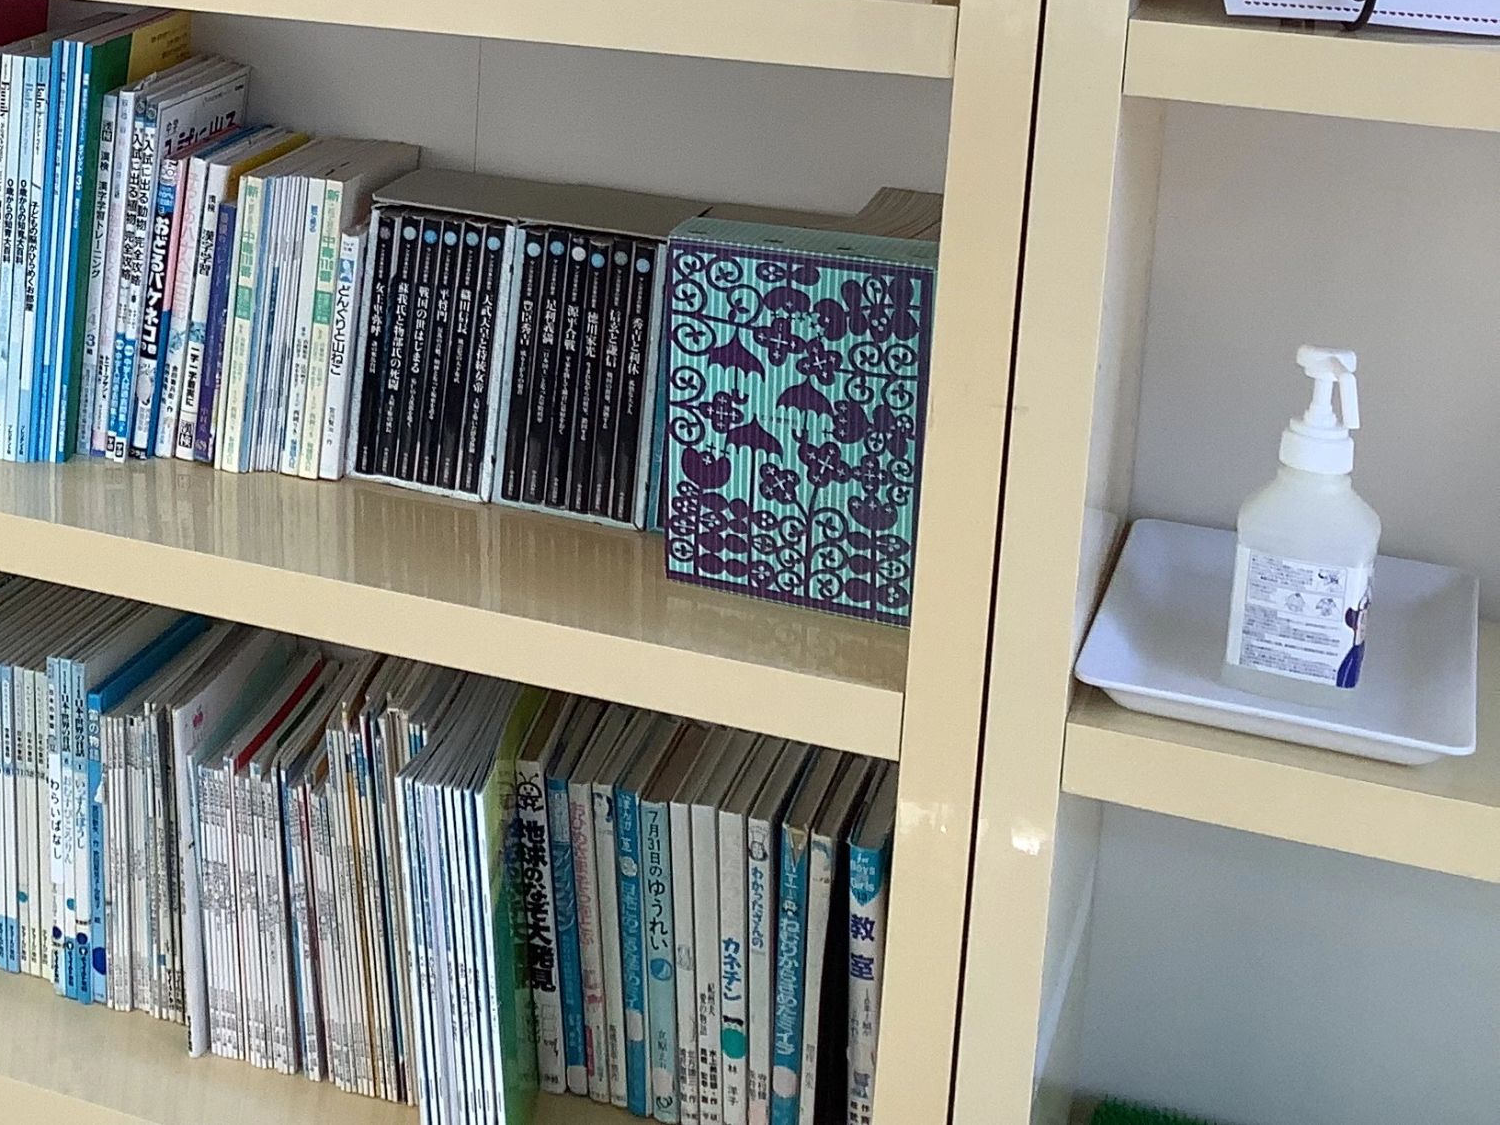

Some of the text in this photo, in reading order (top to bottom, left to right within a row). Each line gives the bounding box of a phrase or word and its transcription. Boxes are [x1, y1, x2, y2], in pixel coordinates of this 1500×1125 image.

[124, 133, 144, 225] 入試に出る植物
[135, 137, 154, 230] 入試に出る動物
[2, 178, 14, 264] 0歳からの知育大百科
[15, 179, 27, 265] 0歳からの知育大百科
[328, 284, 350, 377] どんぐりと山ねこ
[370, 282, 387, 337] 女王卑弥呼
[411, 286, 430, 373] 戦国の世はじまる
[436, 288, 449, 323] 平将門
[457, 289, 472, 335] 織田信長
[520, 300, 534, 346] 豊臣秀吉
[585, 312, 599, 358] 徳川家光
[605, 309, 621, 368] 信玄と謙信
[627, 318, 644, 375] 秀吉と利休
[50, 780, 63, 860] わらいばなし
[74, 779, 86, 850] いっすんぼうし
[514, 819, 557, 992] 地球のなぞ大発見
[647, 811, 669, 950] 7月31日のゆうれい
[751, 866, 765, 950] わかったさんの
[850, 877, 875, 892] Girls
[722, 936, 743, 1002] カネチン
[850, 914, 875, 981] 教室
